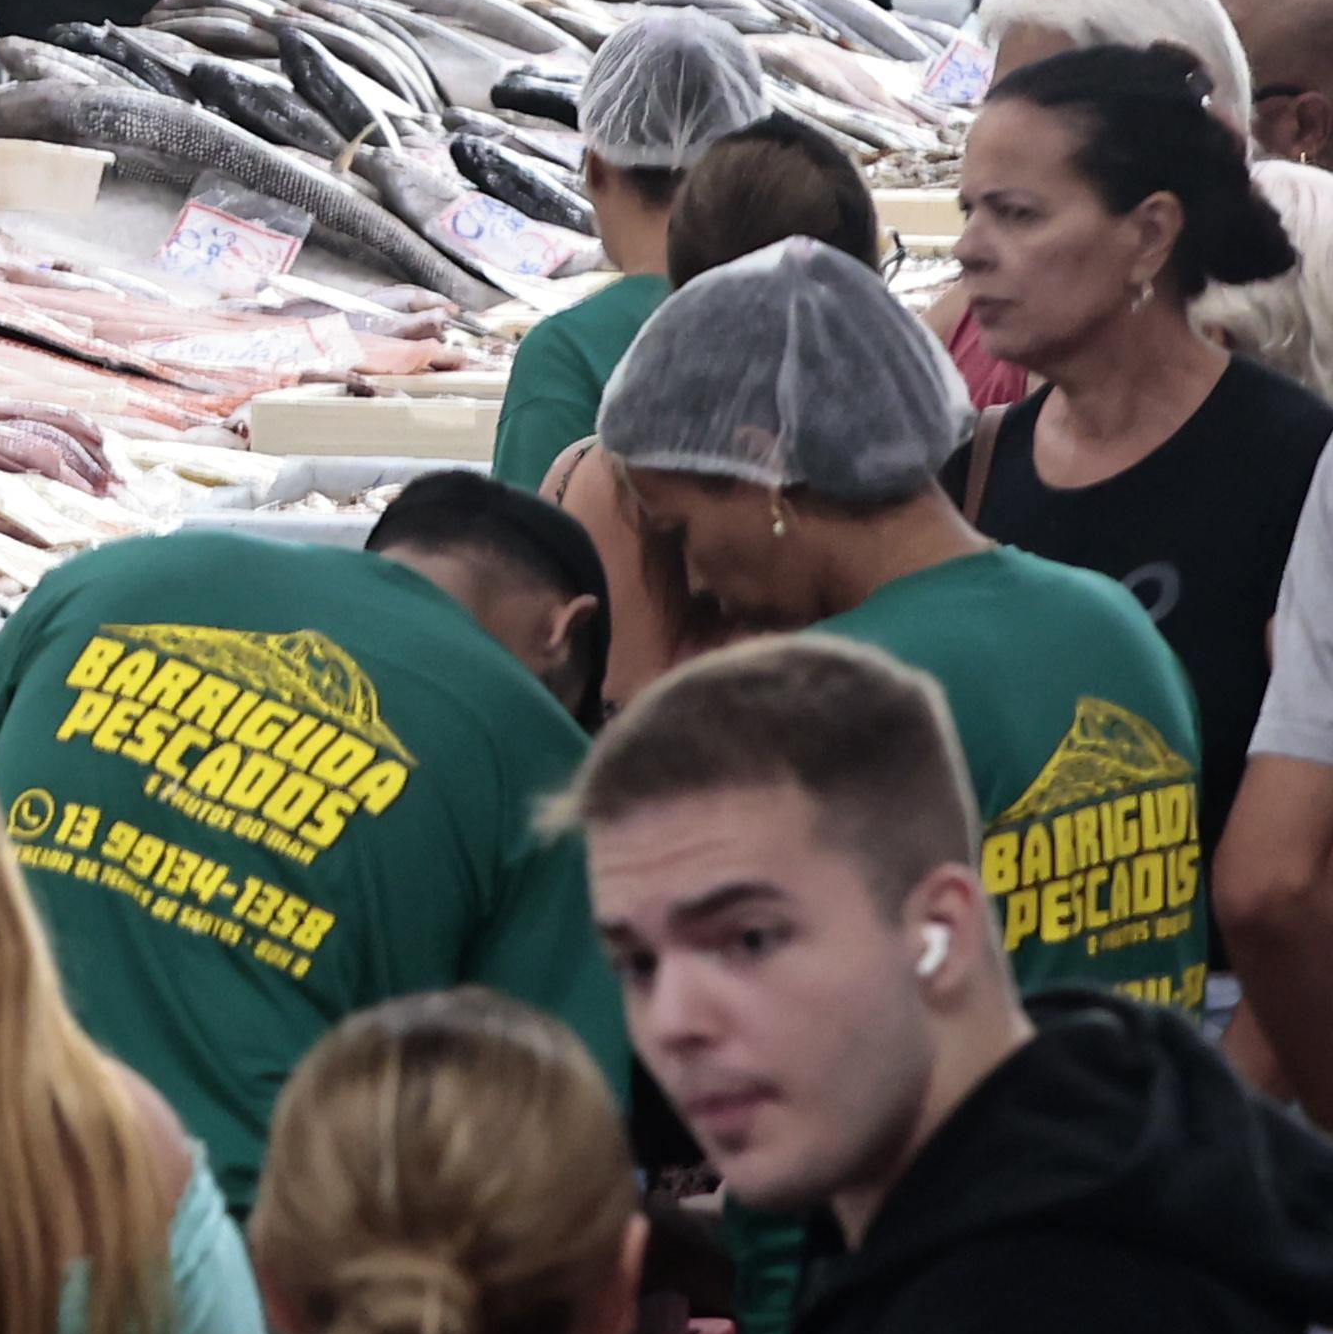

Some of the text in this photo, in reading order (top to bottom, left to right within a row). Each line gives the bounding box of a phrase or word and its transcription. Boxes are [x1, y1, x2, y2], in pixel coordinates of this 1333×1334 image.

[54, 688, 359, 853] PESCADOS
[64, 634, 411, 818] BARRIGUDA
[53, 802, 337, 953] 13 99134-1358
